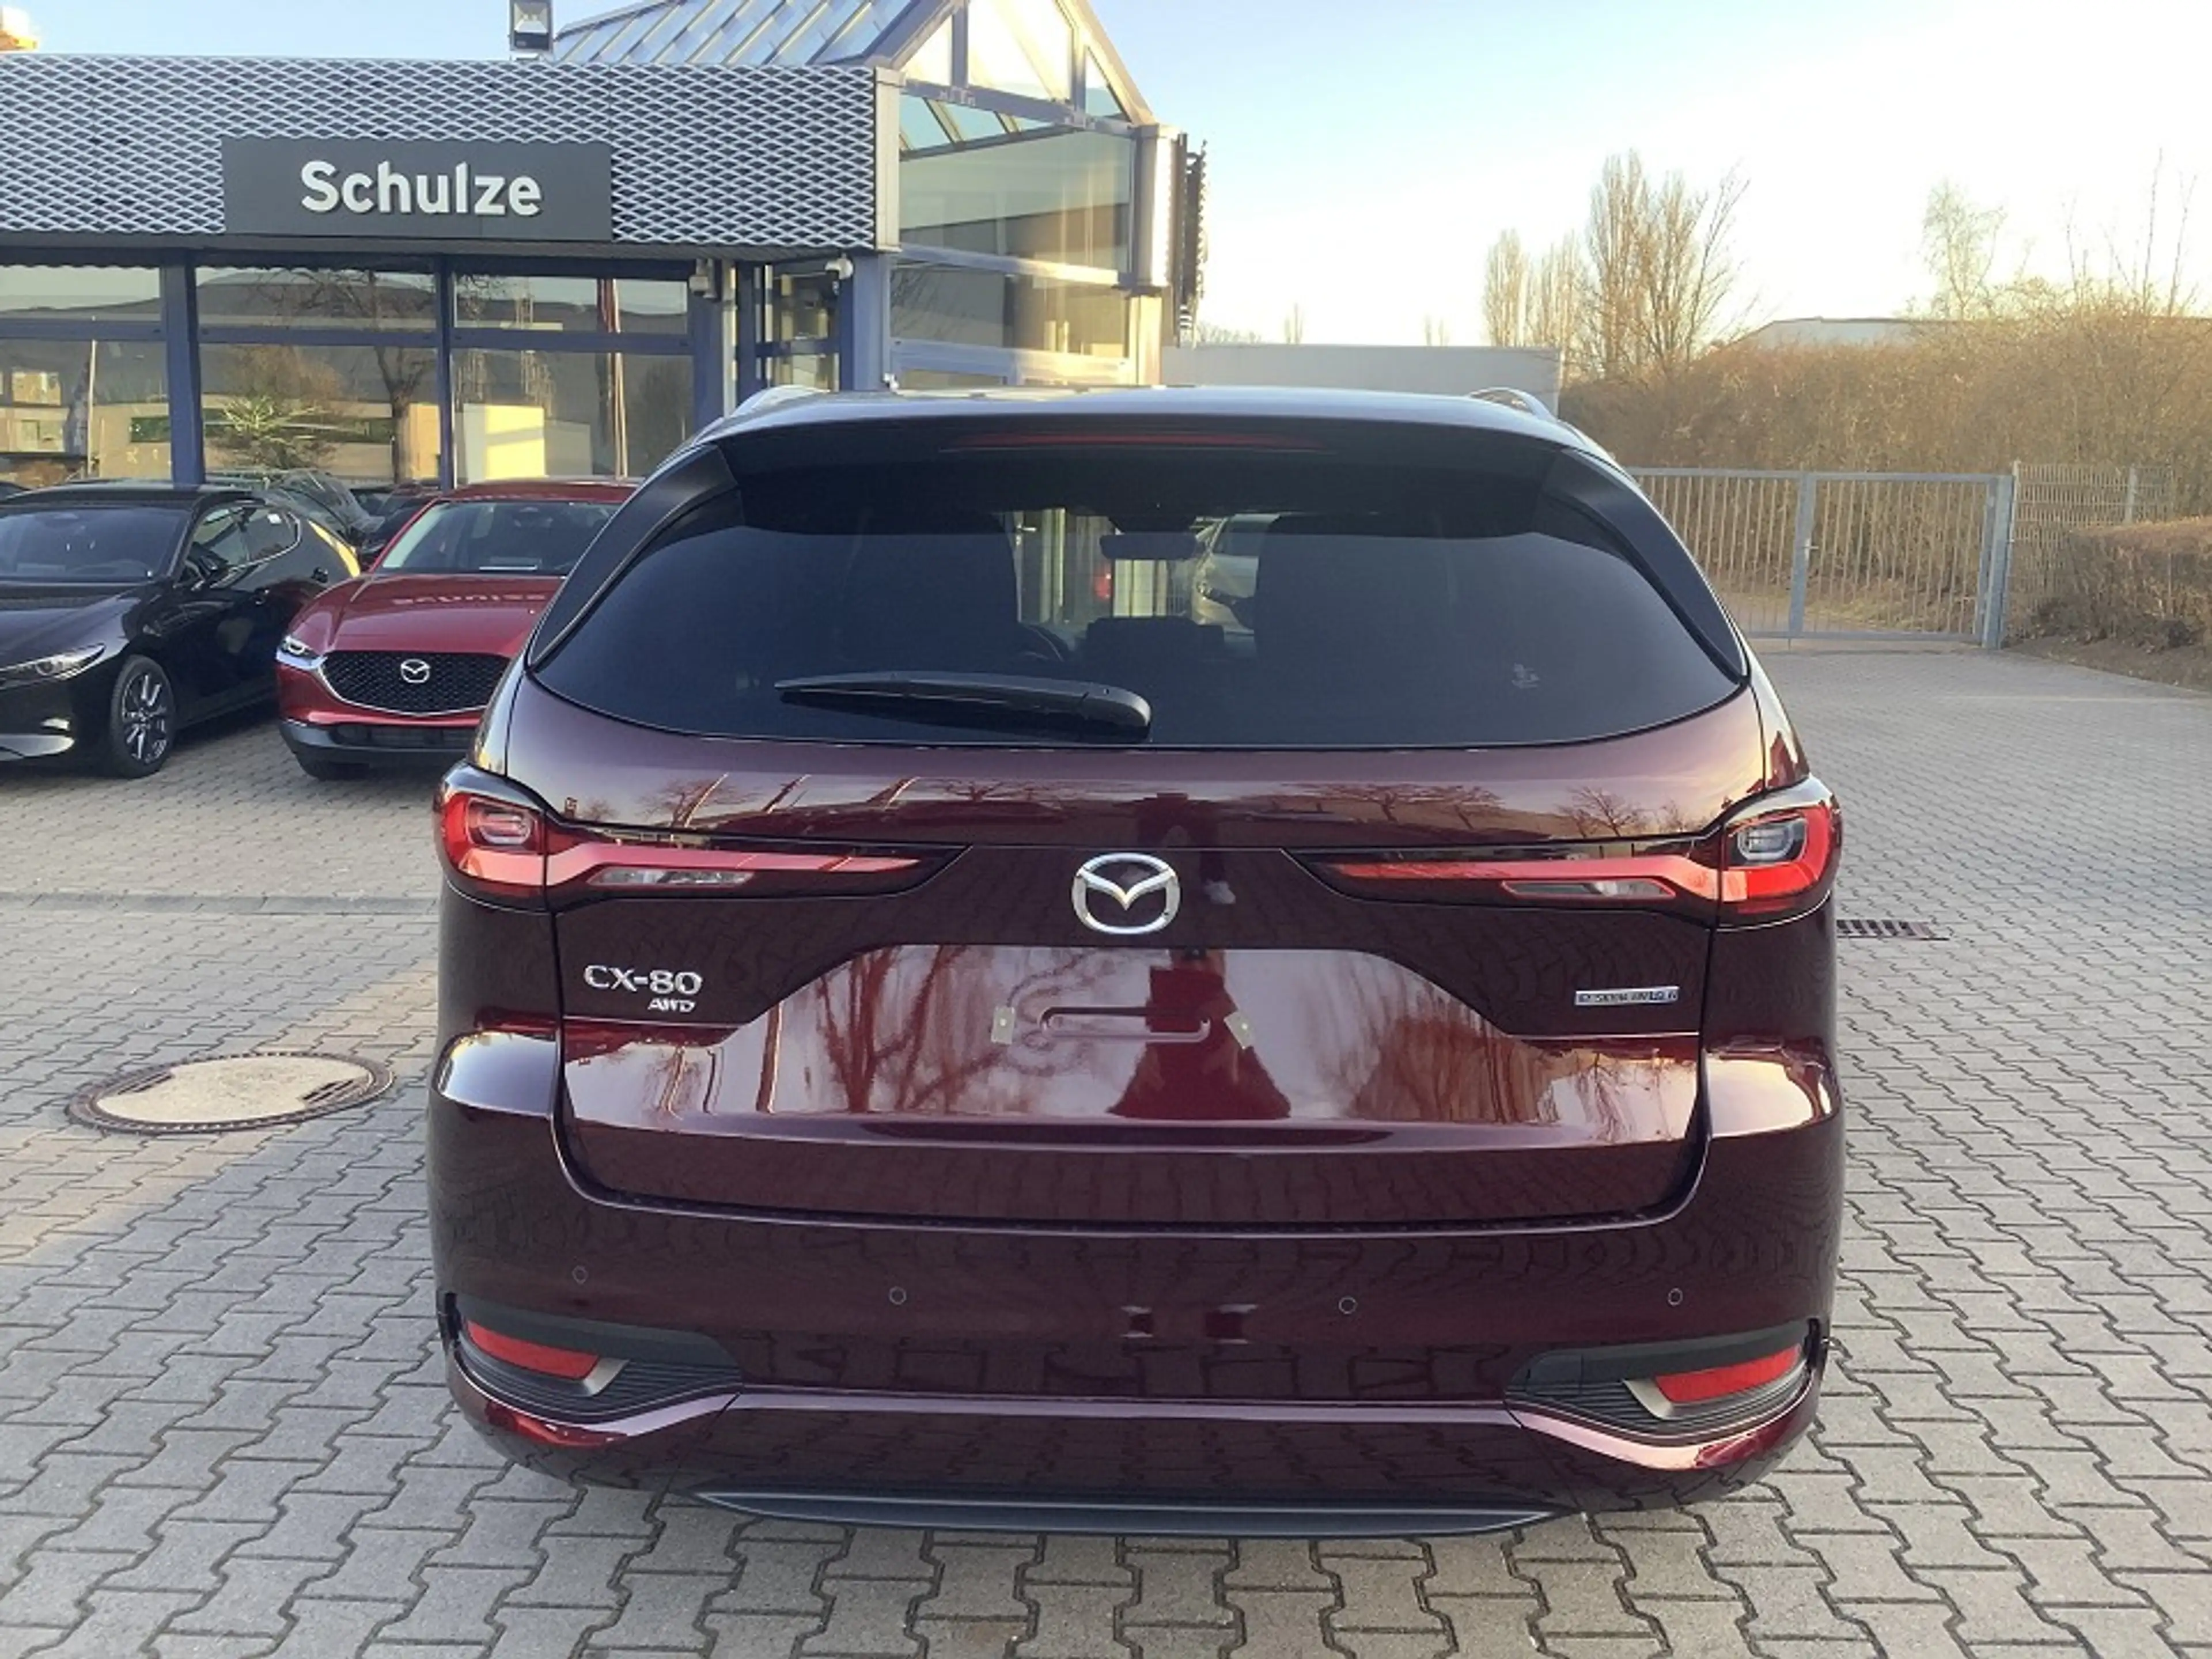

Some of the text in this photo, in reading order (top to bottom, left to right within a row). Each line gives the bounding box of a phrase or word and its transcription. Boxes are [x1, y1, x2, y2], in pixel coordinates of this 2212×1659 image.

[301, 160, 541, 216] Schulze
[584, 964, 703, 995] CX-80
[647, 997, 696, 1013] AWD
